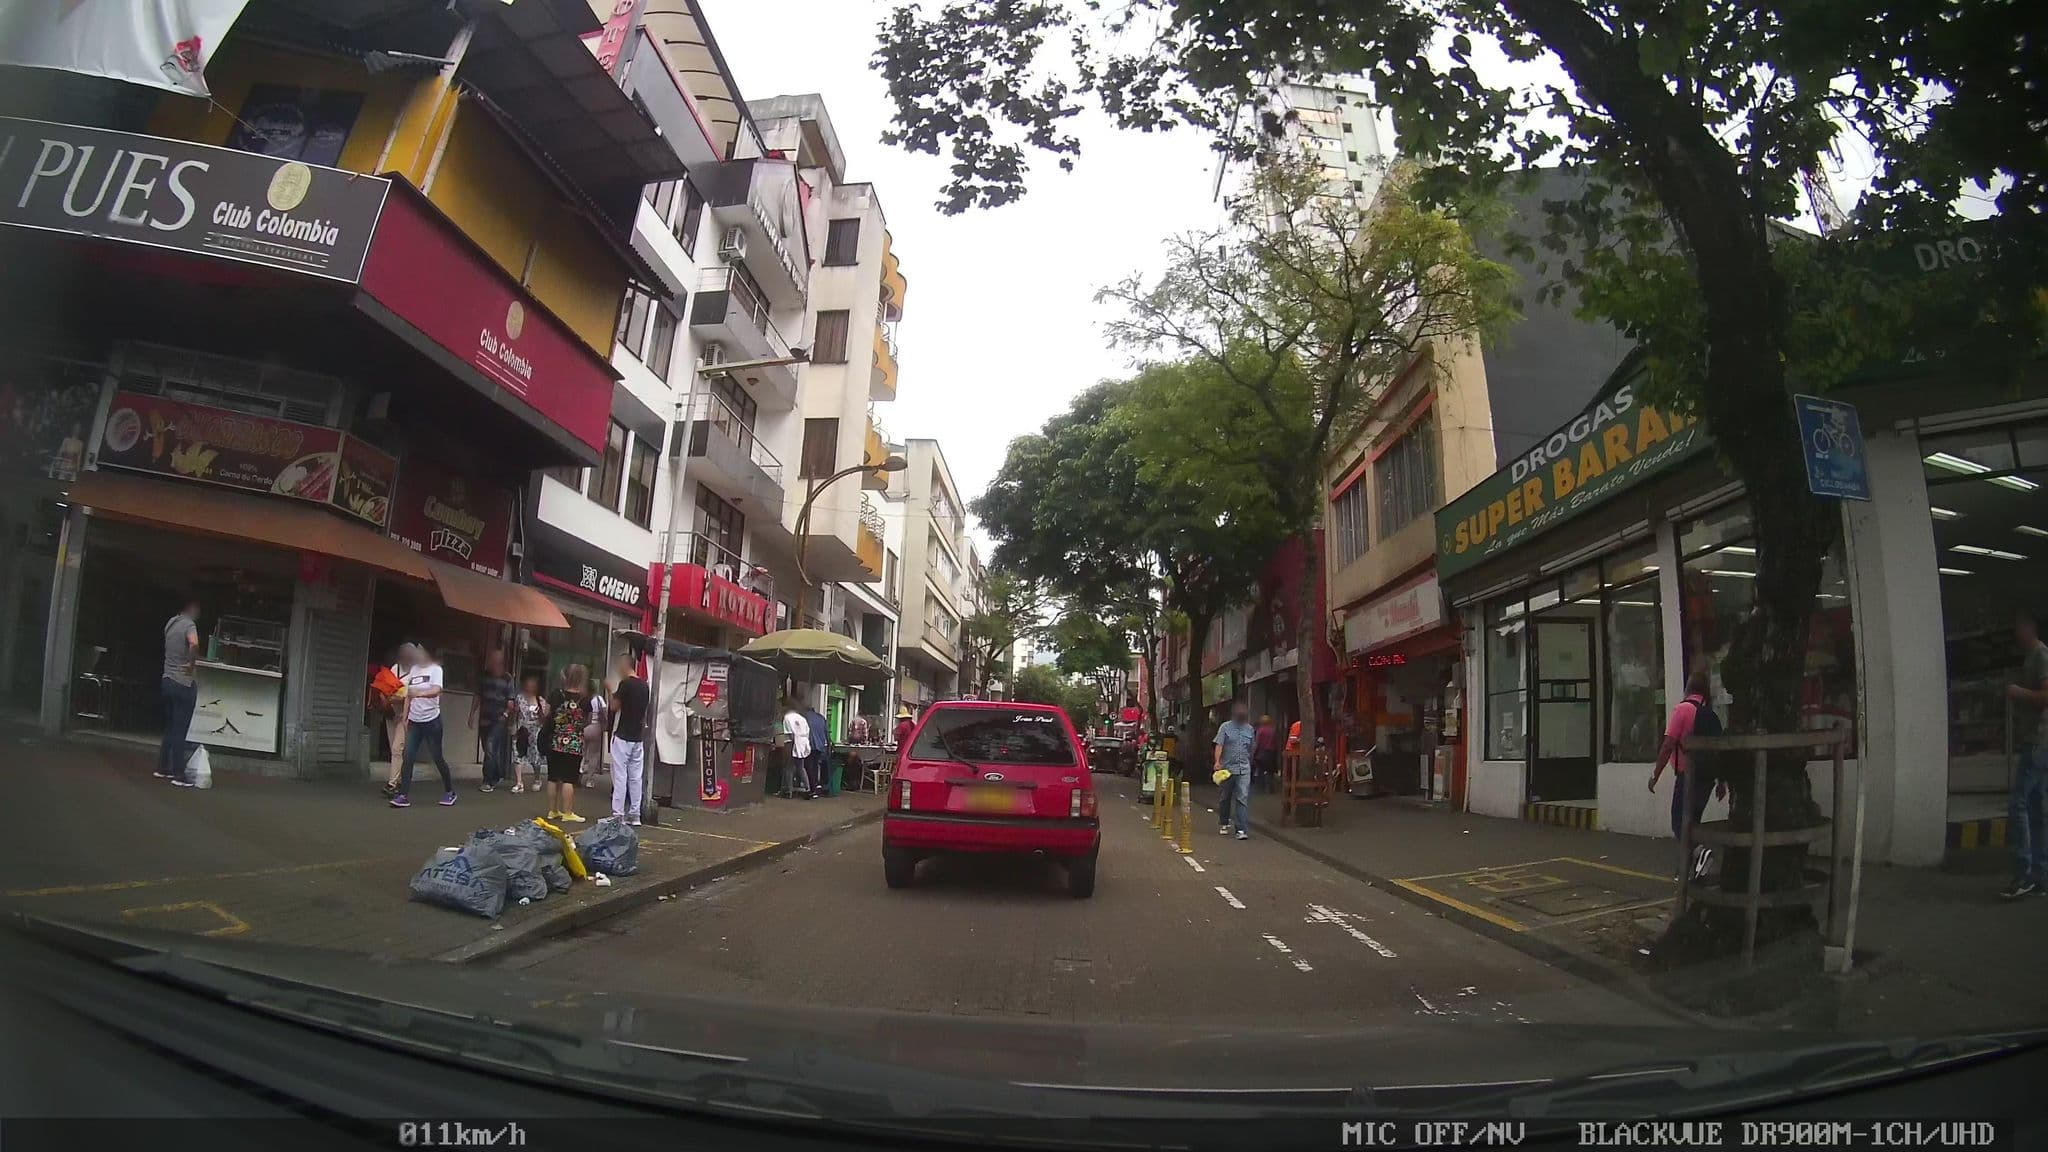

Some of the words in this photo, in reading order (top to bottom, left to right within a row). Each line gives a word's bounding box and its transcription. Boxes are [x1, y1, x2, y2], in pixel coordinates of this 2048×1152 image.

[17, 138, 210, 232] PUES
[212, 200, 252, 230] Club
[256, 208, 340, 247] Colombia
[1913, 236, 1982, 272] DRO
[479, 328, 499, 355] Club
[499, 342, 533, 381] Colombia
[1511, 384, 1634, 485] DROGAS
[1454, 475, 1545, 555] SUPER
[1552, 404, 1699, 502] BARA
[1531, 505, 1564, 531] Más
[1569, 474, 1626, 510] Barato
[1628, 429, 1696, 478] Vende!
[598, 574, 640, 605] CHENG
[702, 722, 714, 786] MINUTOS
